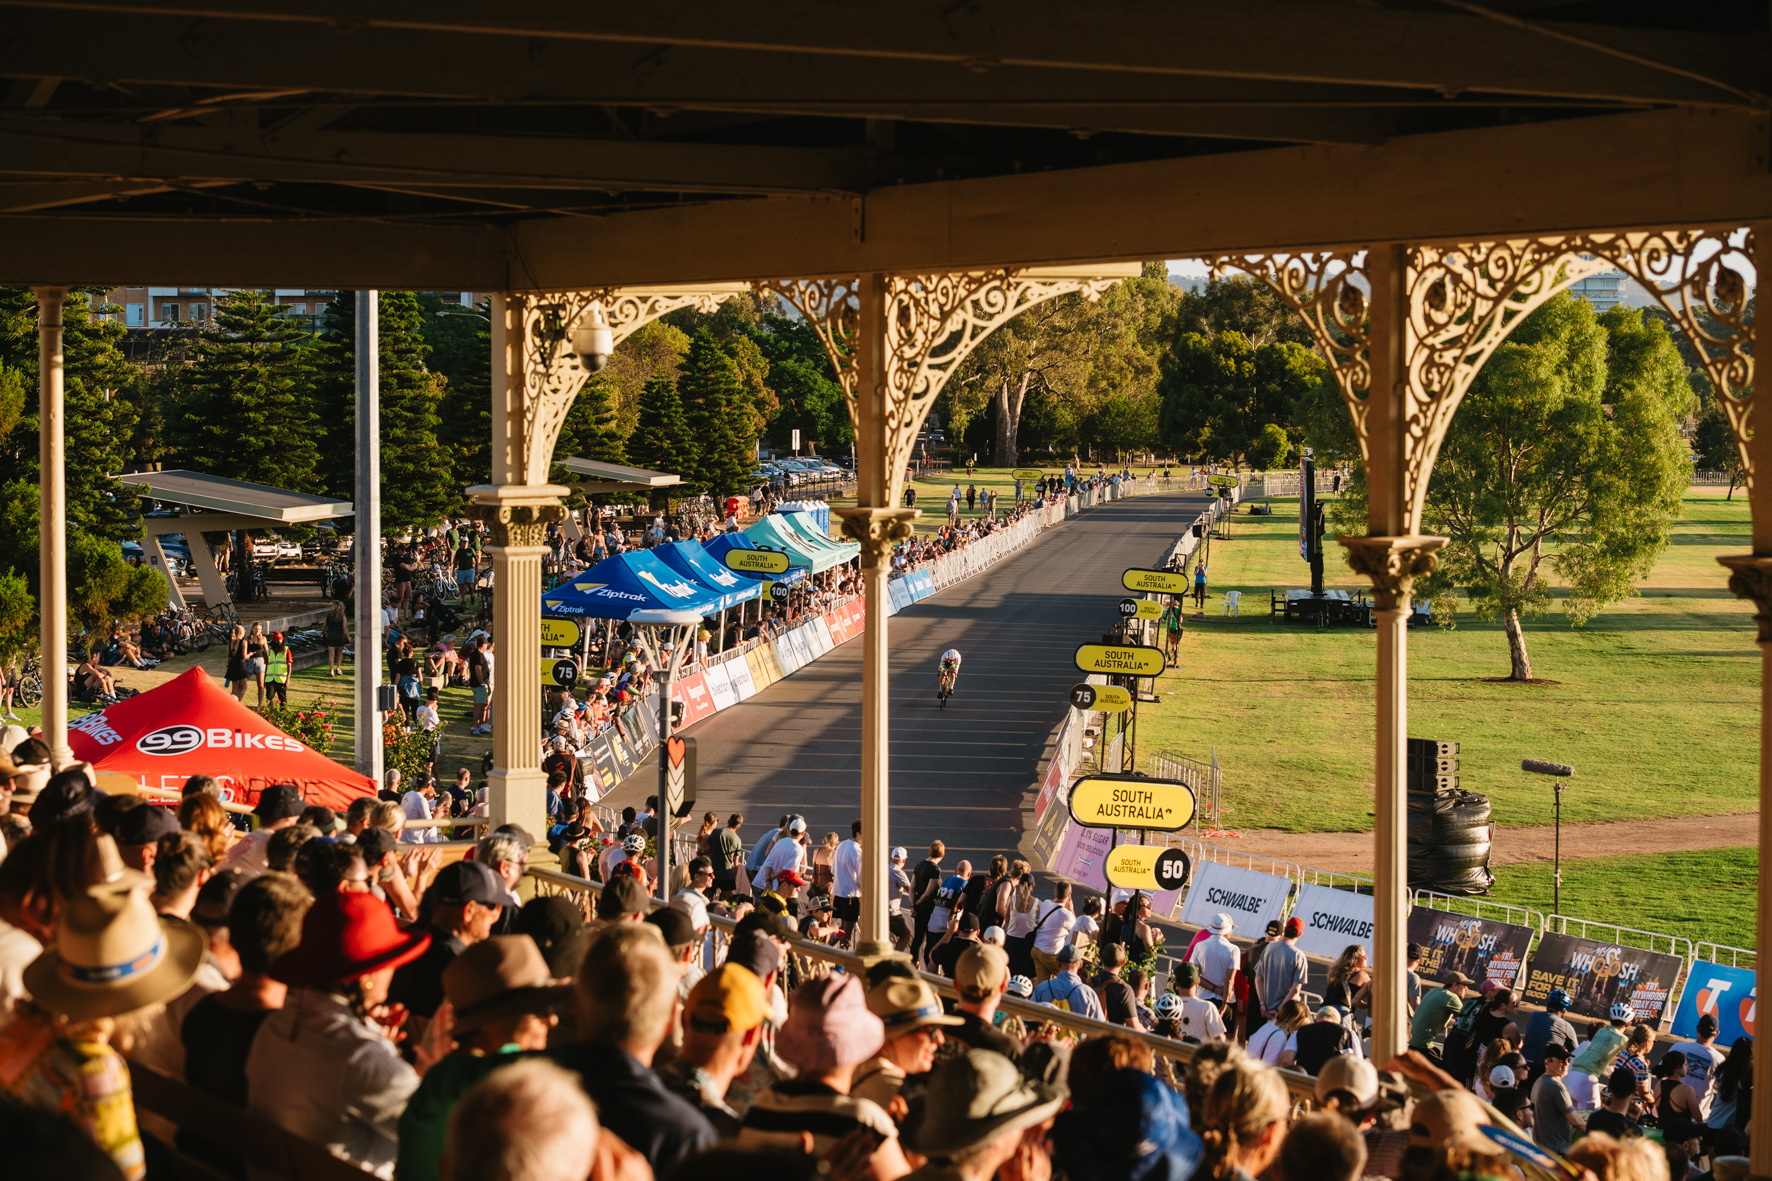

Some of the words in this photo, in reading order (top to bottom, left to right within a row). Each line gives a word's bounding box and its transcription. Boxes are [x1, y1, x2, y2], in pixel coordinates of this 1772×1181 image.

[746, 554, 768, 562] SOUTH
[739, 561, 774, 569] AUSTRALIA
[1144, 574, 1166, 582] SOUTH
[1136, 581, 1172, 589] AUSTRALIA
[597, 588, 646, 602] Ziptrak
[771, 587, 788, 597] 100
[558, 605, 585, 614] Ziptrak
[1119, 603, 1136, 613] 100
[1104, 650, 1134, 660] SOUTH
[1094, 659, 1143, 670] AUSTRALIA
[558, 667, 573, 679] 75
[1076, 690, 1091, 703] 75
[142, 728, 201, 751] 99
[1112, 789, 1153, 804] SOUTH
[1096, 803, 1164, 820] AUSTRALIA
[1092, 832, 1109, 846] SUGAR
[1120, 858, 1141, 867] SOUTH
[1113, 865, 1146, 874] AUSTRALIA
[1162, 860, 1184, 879] 50
[1205, 887, 1262, 914] SCHWALBE
[1309, 911, 1374, 939] SCHWALBE
[1436, 925, 1497, 951] WHOOSH
[1432, 949, 1444, 959] IT
[1501, 952, 1513, 960] TRY
[1488, 960, 1520, 970] MYWHOOSH
[1570, 952, 1639, 981] WHOOSH
[1486, 969, 1504, 978] TODAY
[1504, 970, 1516, 979] FOR
[1530, 969, 1565, 986] SAVE
[1566, 977, 1580, 989] IT
[1527, 980, 1552, 994] FOR
[1646, 982, 1659, 991] TRY
[1525, 989, 1548, 1000] GOOD
[1631, 990, 1668, 1002] MYWHOOSH
[1630, 999, 1649, 1009] TODAY
[1649, 1001, 1663, 1011] FOR
